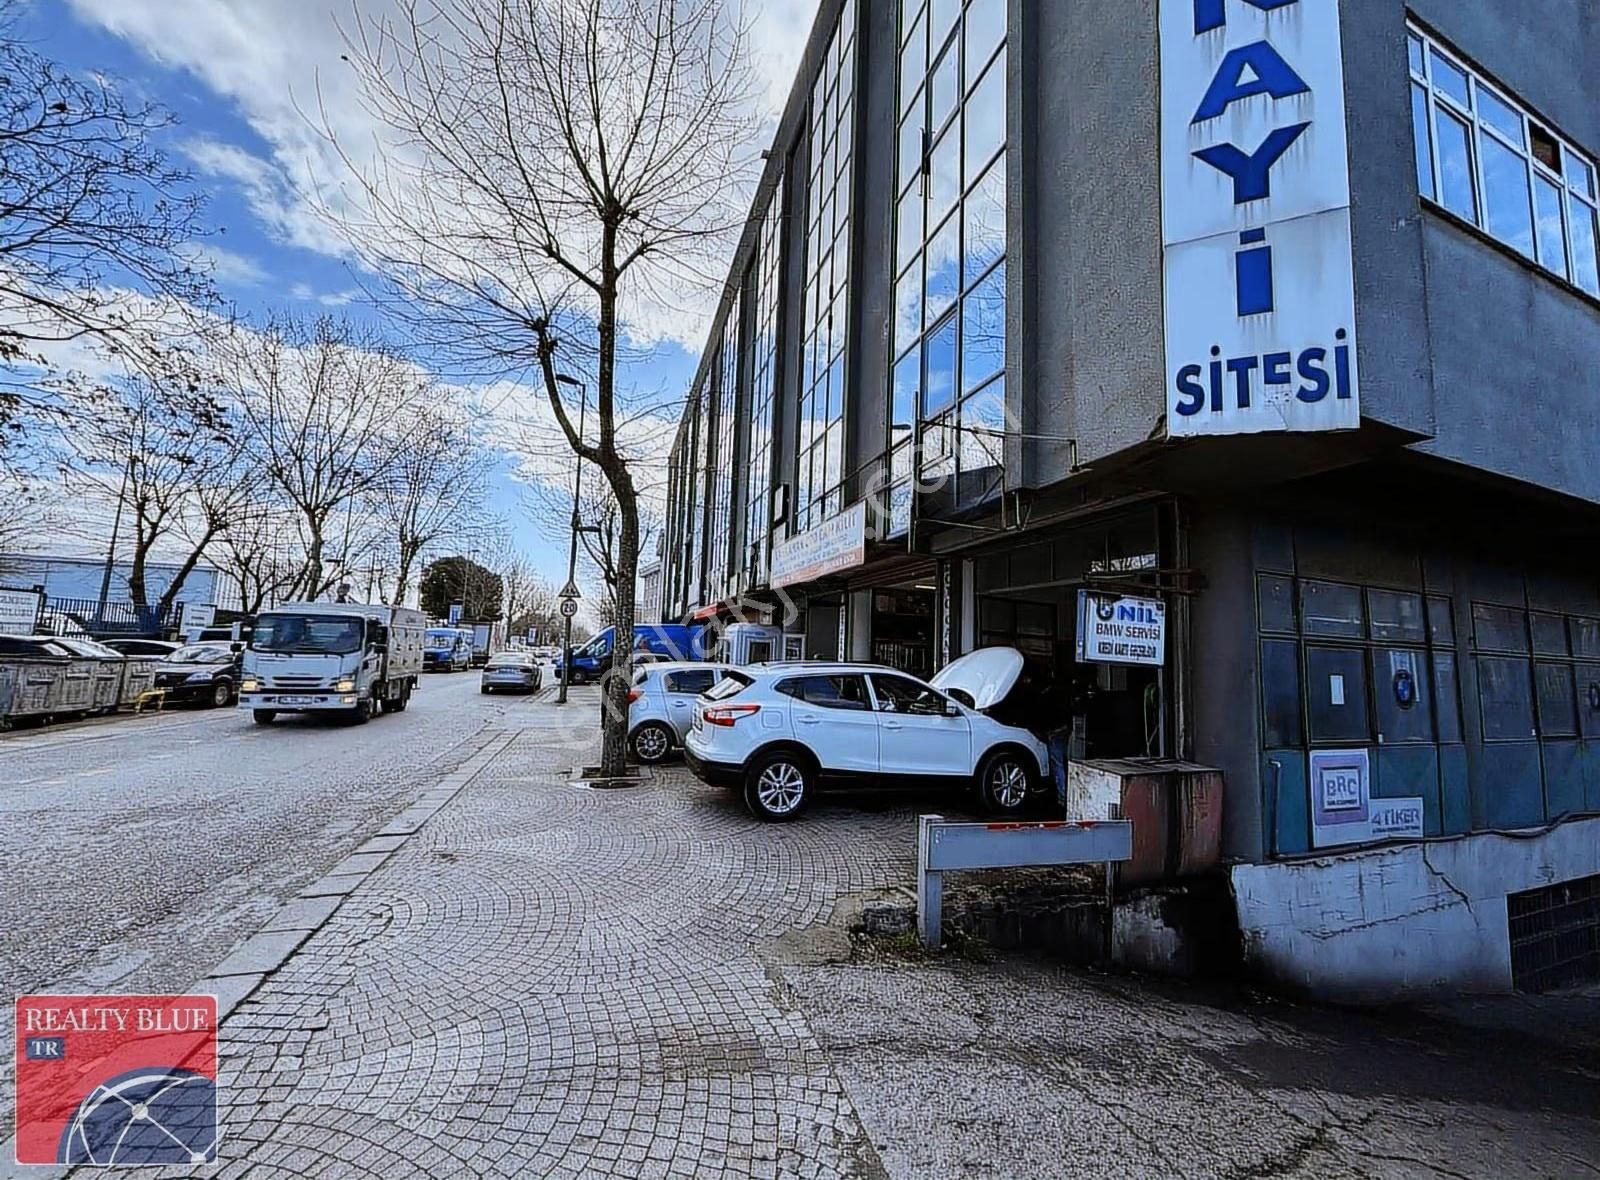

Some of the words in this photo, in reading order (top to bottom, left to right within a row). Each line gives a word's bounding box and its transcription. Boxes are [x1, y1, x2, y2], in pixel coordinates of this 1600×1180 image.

[1190, 0, 1313, 317] AYİ
[1175, 328, 1351, 417] SİTESİ
[1117, 602, 1158, 624] NİL
[1096, 623, 1123, 637] BMW
[1327, 776, 1357, 797] BRC
